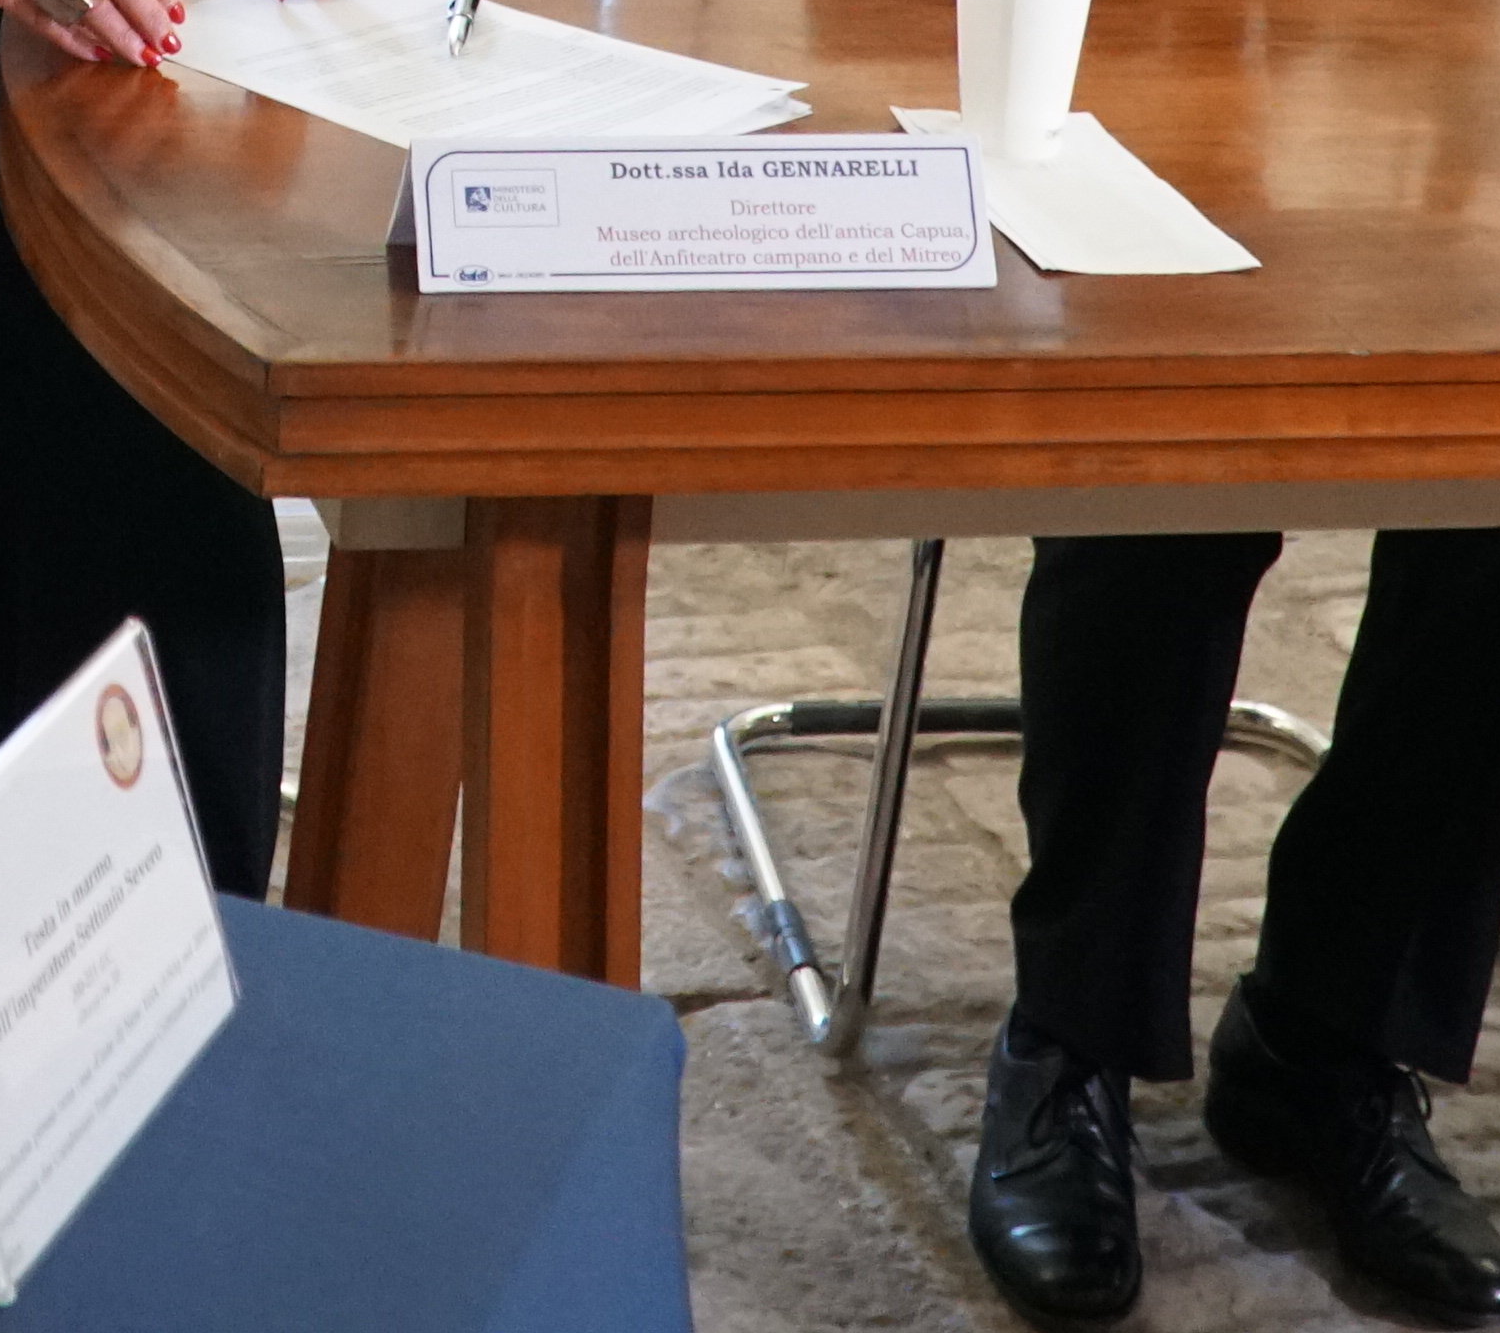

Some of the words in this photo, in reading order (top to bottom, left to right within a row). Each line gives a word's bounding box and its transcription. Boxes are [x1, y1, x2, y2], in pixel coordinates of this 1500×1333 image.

[610, 162, 708, 180] Dott.ssa
[717, 161, 754, 179] Ida
[762, 160, 919, 178] GENNARELLI
[493, 203, 547, 212] CULTURA
[730, 199, 817, 216] Direttore
[597, 226, 661, 242] Museo
[667, 224, 790, 244] archeologico
[795, 223, 895, 240] dell'antica
[901, 222, 970, 242] Capua,
[610, 249, 747, 267] dell'Anfiteatro
[752, 251, 843, 271] campano
[848, 253, 860, 264] e
[865, 247, 894, 264] del
[901, 246, 962, 263] Mitreo
[55, 893, 71, 921] in
[71, 853, 112, 906] marmo
